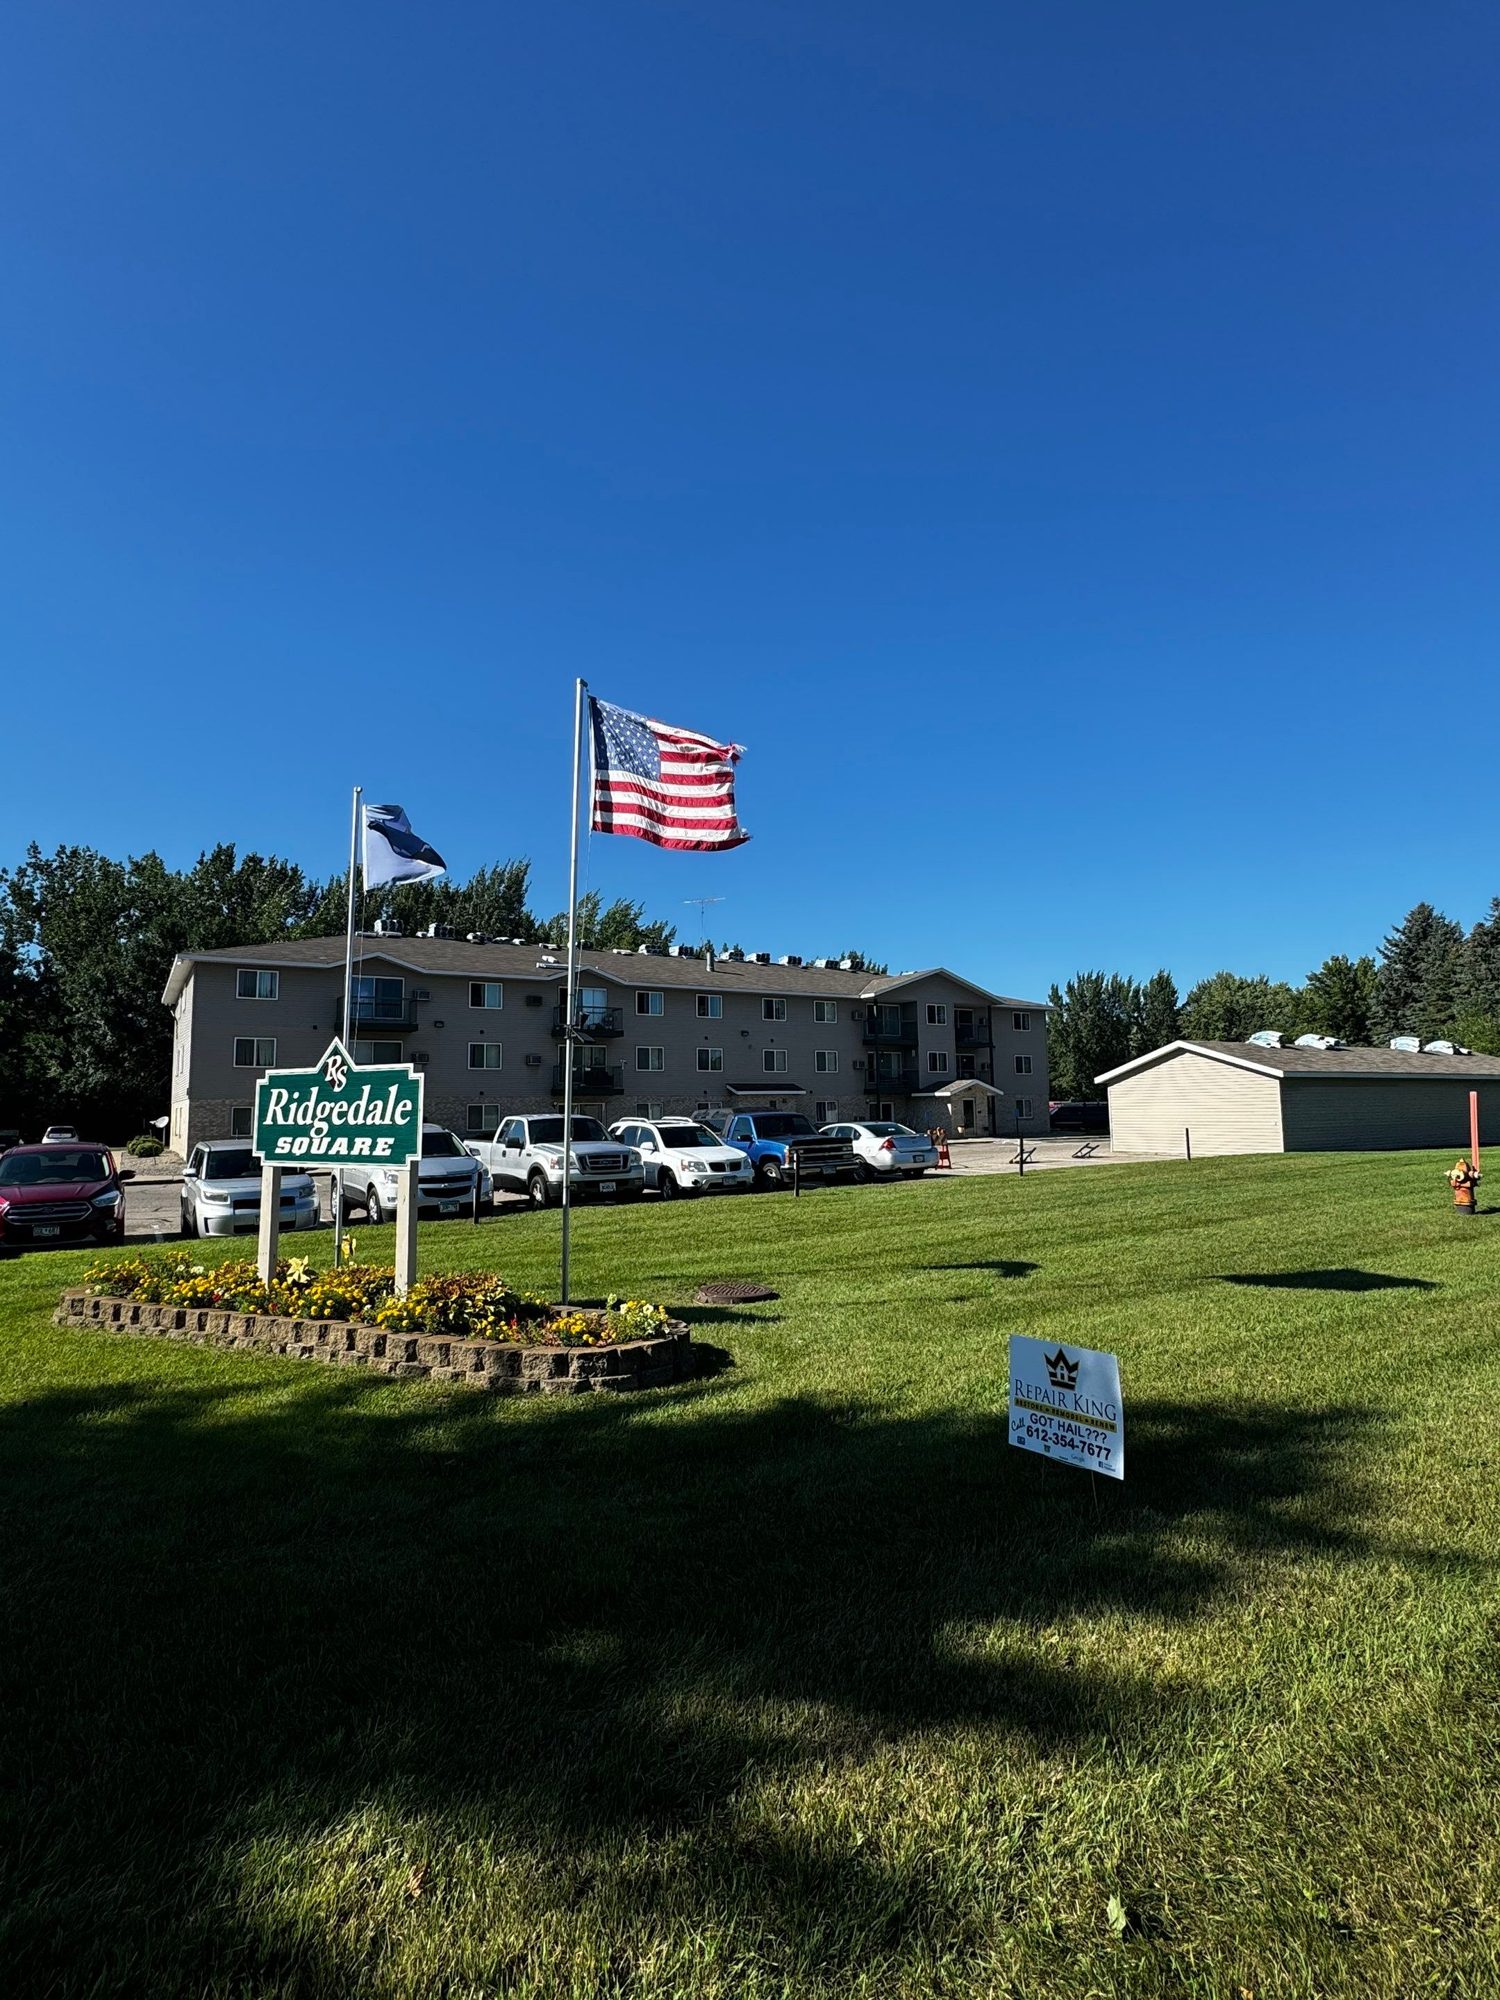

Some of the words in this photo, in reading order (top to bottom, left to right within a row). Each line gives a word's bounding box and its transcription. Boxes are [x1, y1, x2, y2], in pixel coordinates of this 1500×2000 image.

[263, 1084, 412, 1137] Ridgedale
[274, 1137, 395, 1156] SQUARE
[1011, 1417, 1025, 1432] Call
[1030, 1413, 1054, 1428] GOT
[1058, 1420, 1107, 1444] HAIL???
[1026, 1425, 1111, 1461] 612-354-7677
